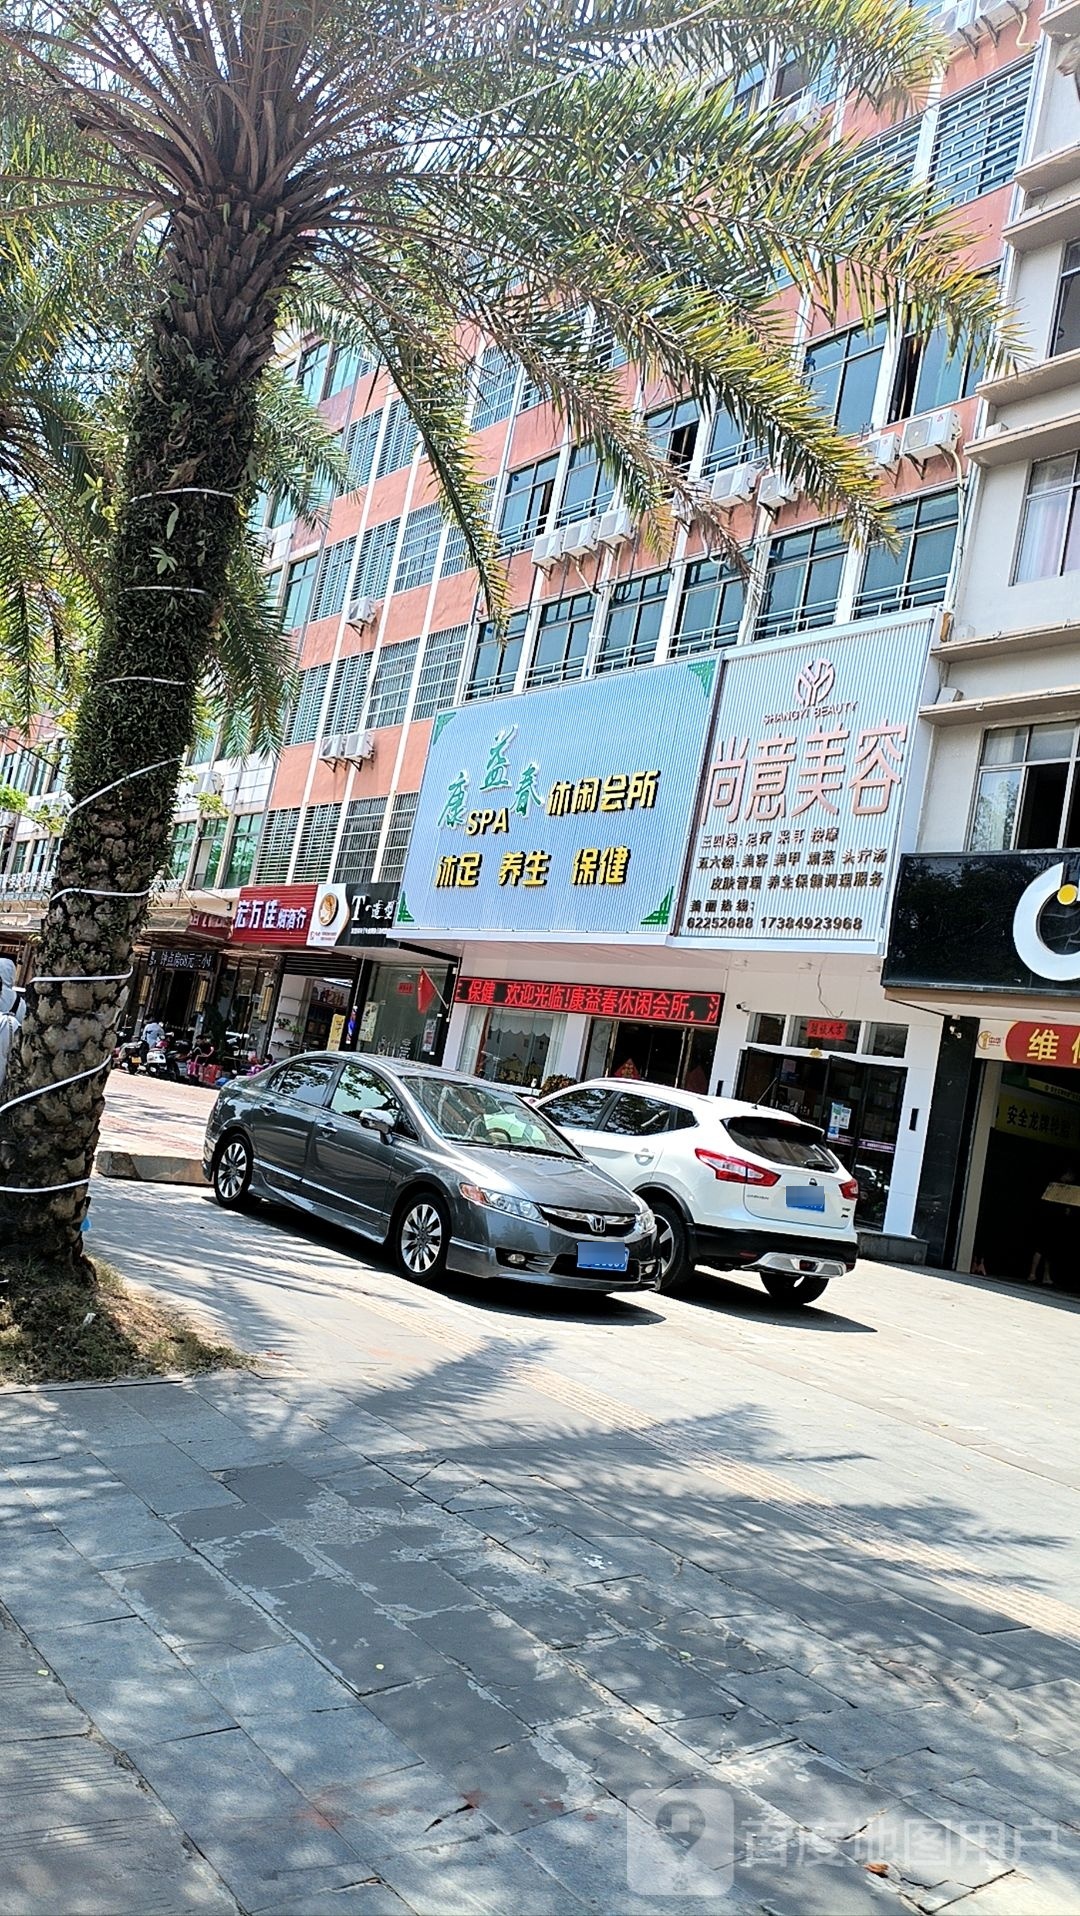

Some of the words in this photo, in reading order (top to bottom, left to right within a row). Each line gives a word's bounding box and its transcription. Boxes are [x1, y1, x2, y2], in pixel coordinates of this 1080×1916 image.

[763, 708, 811, 725] SHANGYI
[814, 700, 859, 718] BEAUTY
[437, 723, 545, 828] 康益春
[546, 770, 661, 816] 休闲会所
[701, 720, 908, 826] 尚意美容
[466, 809, 510, 835] SPA
[811, 827, 839, 843] 按摩
[434, 852, 482, 888] 沐足
[498, 850, 551, 886] 养生
[571, 845, 631, 885] 保健
[773, 851, 800, 867] 美甲
[711, 875, 762, 890] 皮肤管理
[767, 871, 884, 889] 养生保健调理服务
[760, 916, 863, 930] 17384923968
[468, 979, 496, 1003] 保健
[1026, 1028, 1080, 1065] 维
